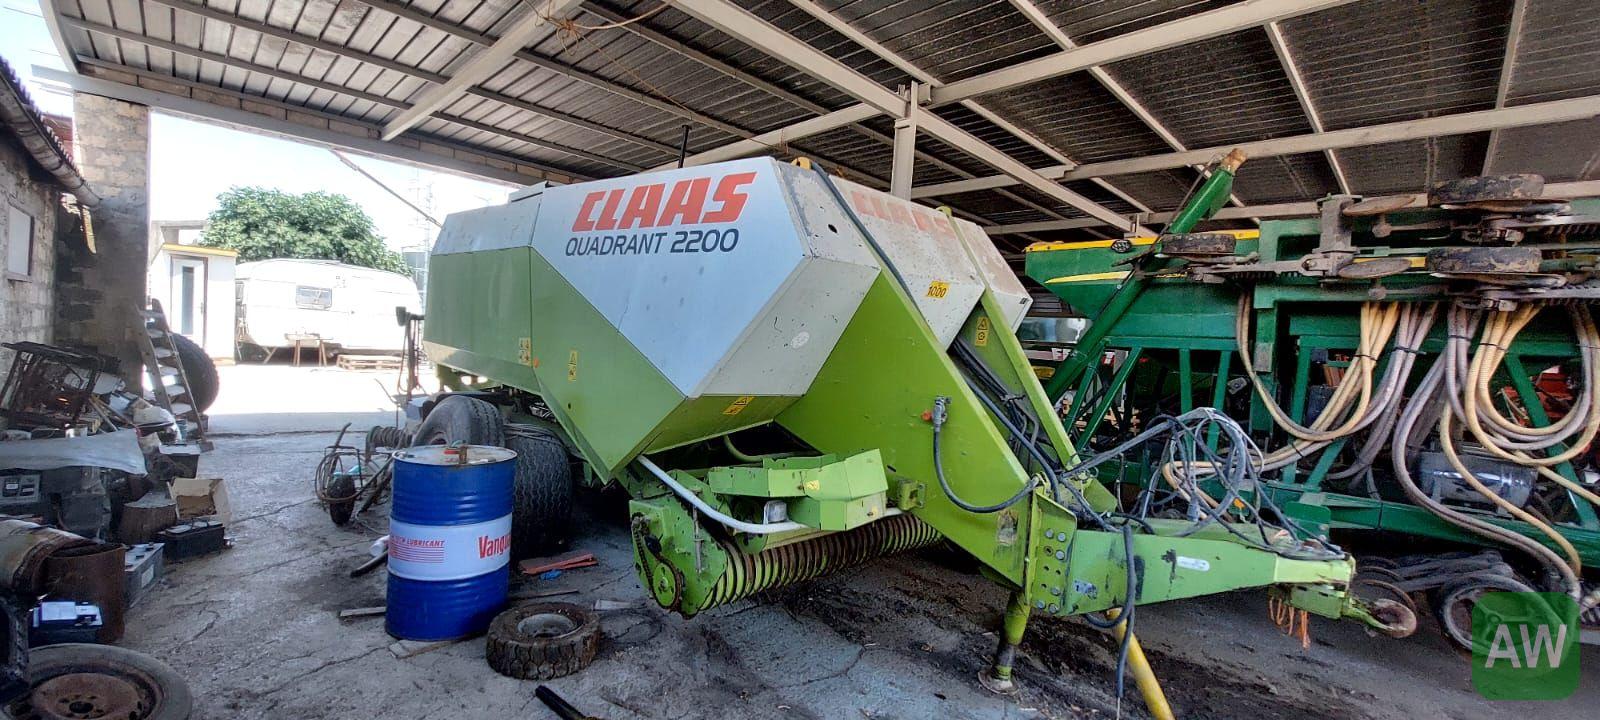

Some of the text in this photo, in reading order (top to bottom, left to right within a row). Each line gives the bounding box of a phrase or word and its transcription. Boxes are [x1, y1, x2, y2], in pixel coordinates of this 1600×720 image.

[572, 172, 757, 232] CLAAS
[566, 229, 739, 257] QUADRANT 2200
[927, 286, 947, 298] 1000
[407, 538, 446, 547] LUBRICANT
